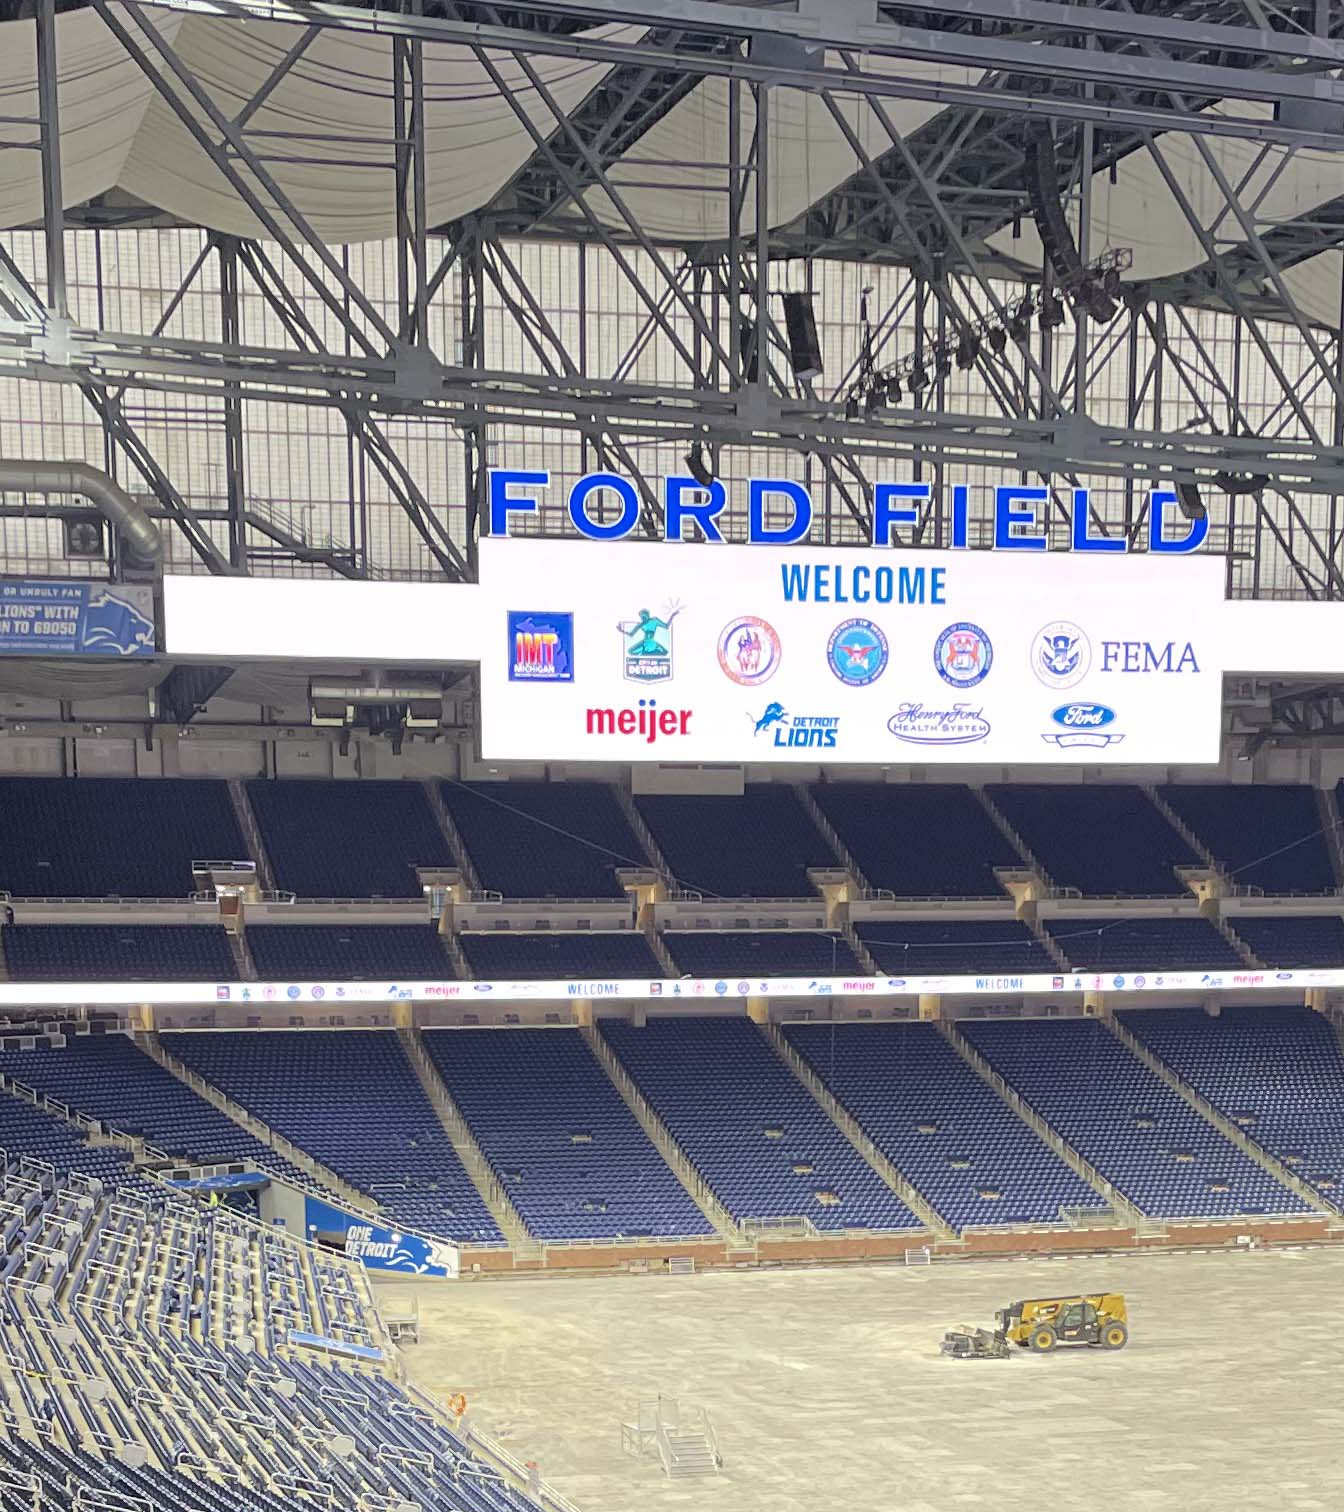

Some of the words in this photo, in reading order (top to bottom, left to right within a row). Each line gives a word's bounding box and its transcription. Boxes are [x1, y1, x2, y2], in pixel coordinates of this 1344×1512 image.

[488, 468, 813, 545] FORD
[871, 481, 1210, 554] FIELD
[780, 563, 947, 605] WELCOME
[4, 587, 18, 597] OR
[20, 587, 58, 598] UNRULY
[61, 588, 83, 599] FAN
[44, 605, 79, 620] WITH
[13, 620, 29, 635] TO
[34, 621, 77, 636] 69050
[516, 631, 559, 666] IMT
[1101, 641, 1201, 673] FEMA
[514, 664, 555, 674] MICHIGAN
[628, 665, 669, 675] DETROIT
[586, 699, 692, 744] meijer
[792, 716, 841, 728] DETROIT
[897, 702, 950, 726] Henry
[947, 702, 984, 724] Ford
[1063, 705, 1104, 725] Ford
[893, 723, 938, 732] HEALTH
[942, 723, 987, 732] SYSTEM
[774, 727, 838, 747] LIONS
[843, 980, 875, 991] meijer
[975, 977, 1023, 989] WELCOME
[1233, 974, 1264, 985] meijer
[424, 984, 460, 996] meijer
[568, 983, 619, 995] WELCOME
[346, 1225, 373, 1241] ONE
[345, 1239, 398, 1258] DETROIT
